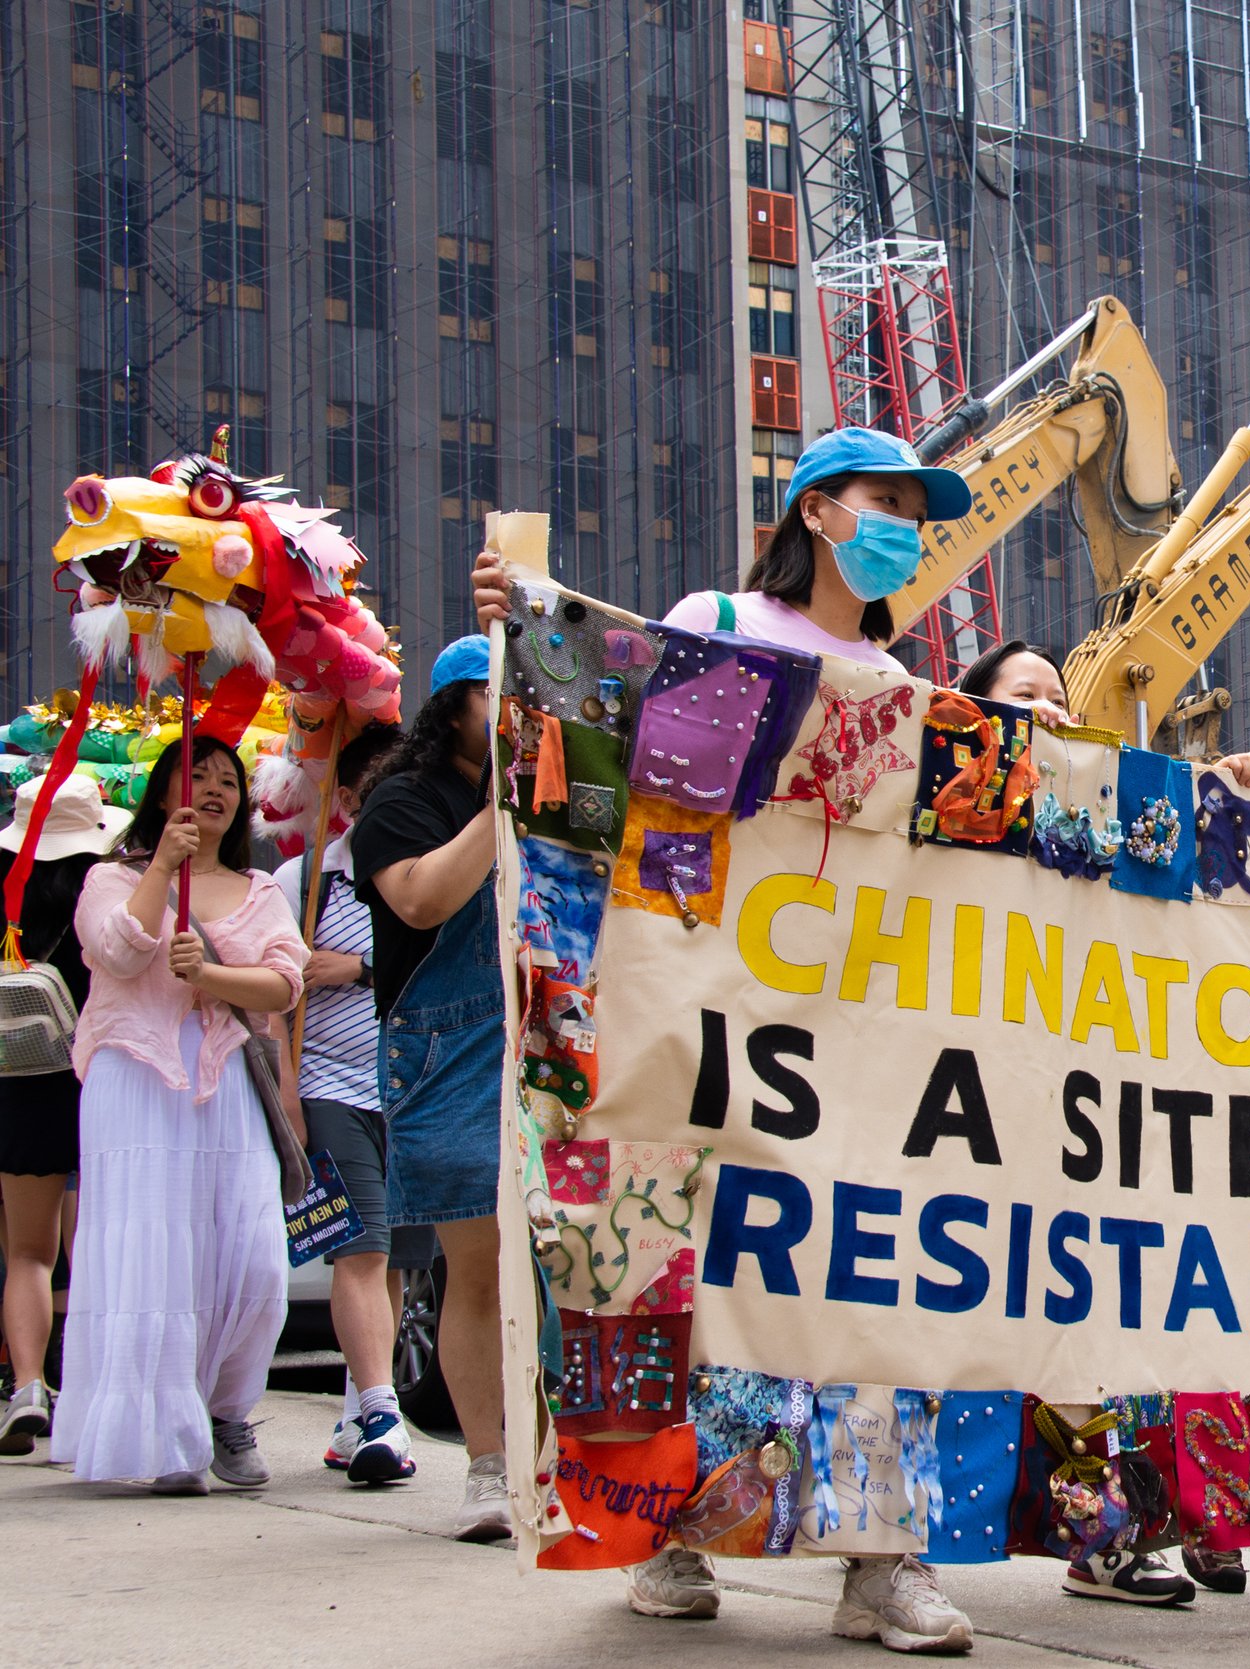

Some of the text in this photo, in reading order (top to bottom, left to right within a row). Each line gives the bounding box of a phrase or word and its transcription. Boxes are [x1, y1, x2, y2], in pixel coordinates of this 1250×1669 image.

[906, 449, 1044, 586] RAMERCY
[688, 1008, 821, 1140] IS
[902, 1048, 1002, 1166] A
[332, 1195, 350, 1213] NO
[309, 1203, 334, 1226] NEW
[294, 1217, 350, 1252] CHINATOWN SAYS
[639, 1237, 676, 1250] BUSY
[842, 1414, 879, 1430] FROM
[857, 1436, 879, 1448] THE
[877, 1454, 893, 1464] TO
[868, 1482, 893, 1495] SEA
[557, 1446, 687, 1550] ommunity
